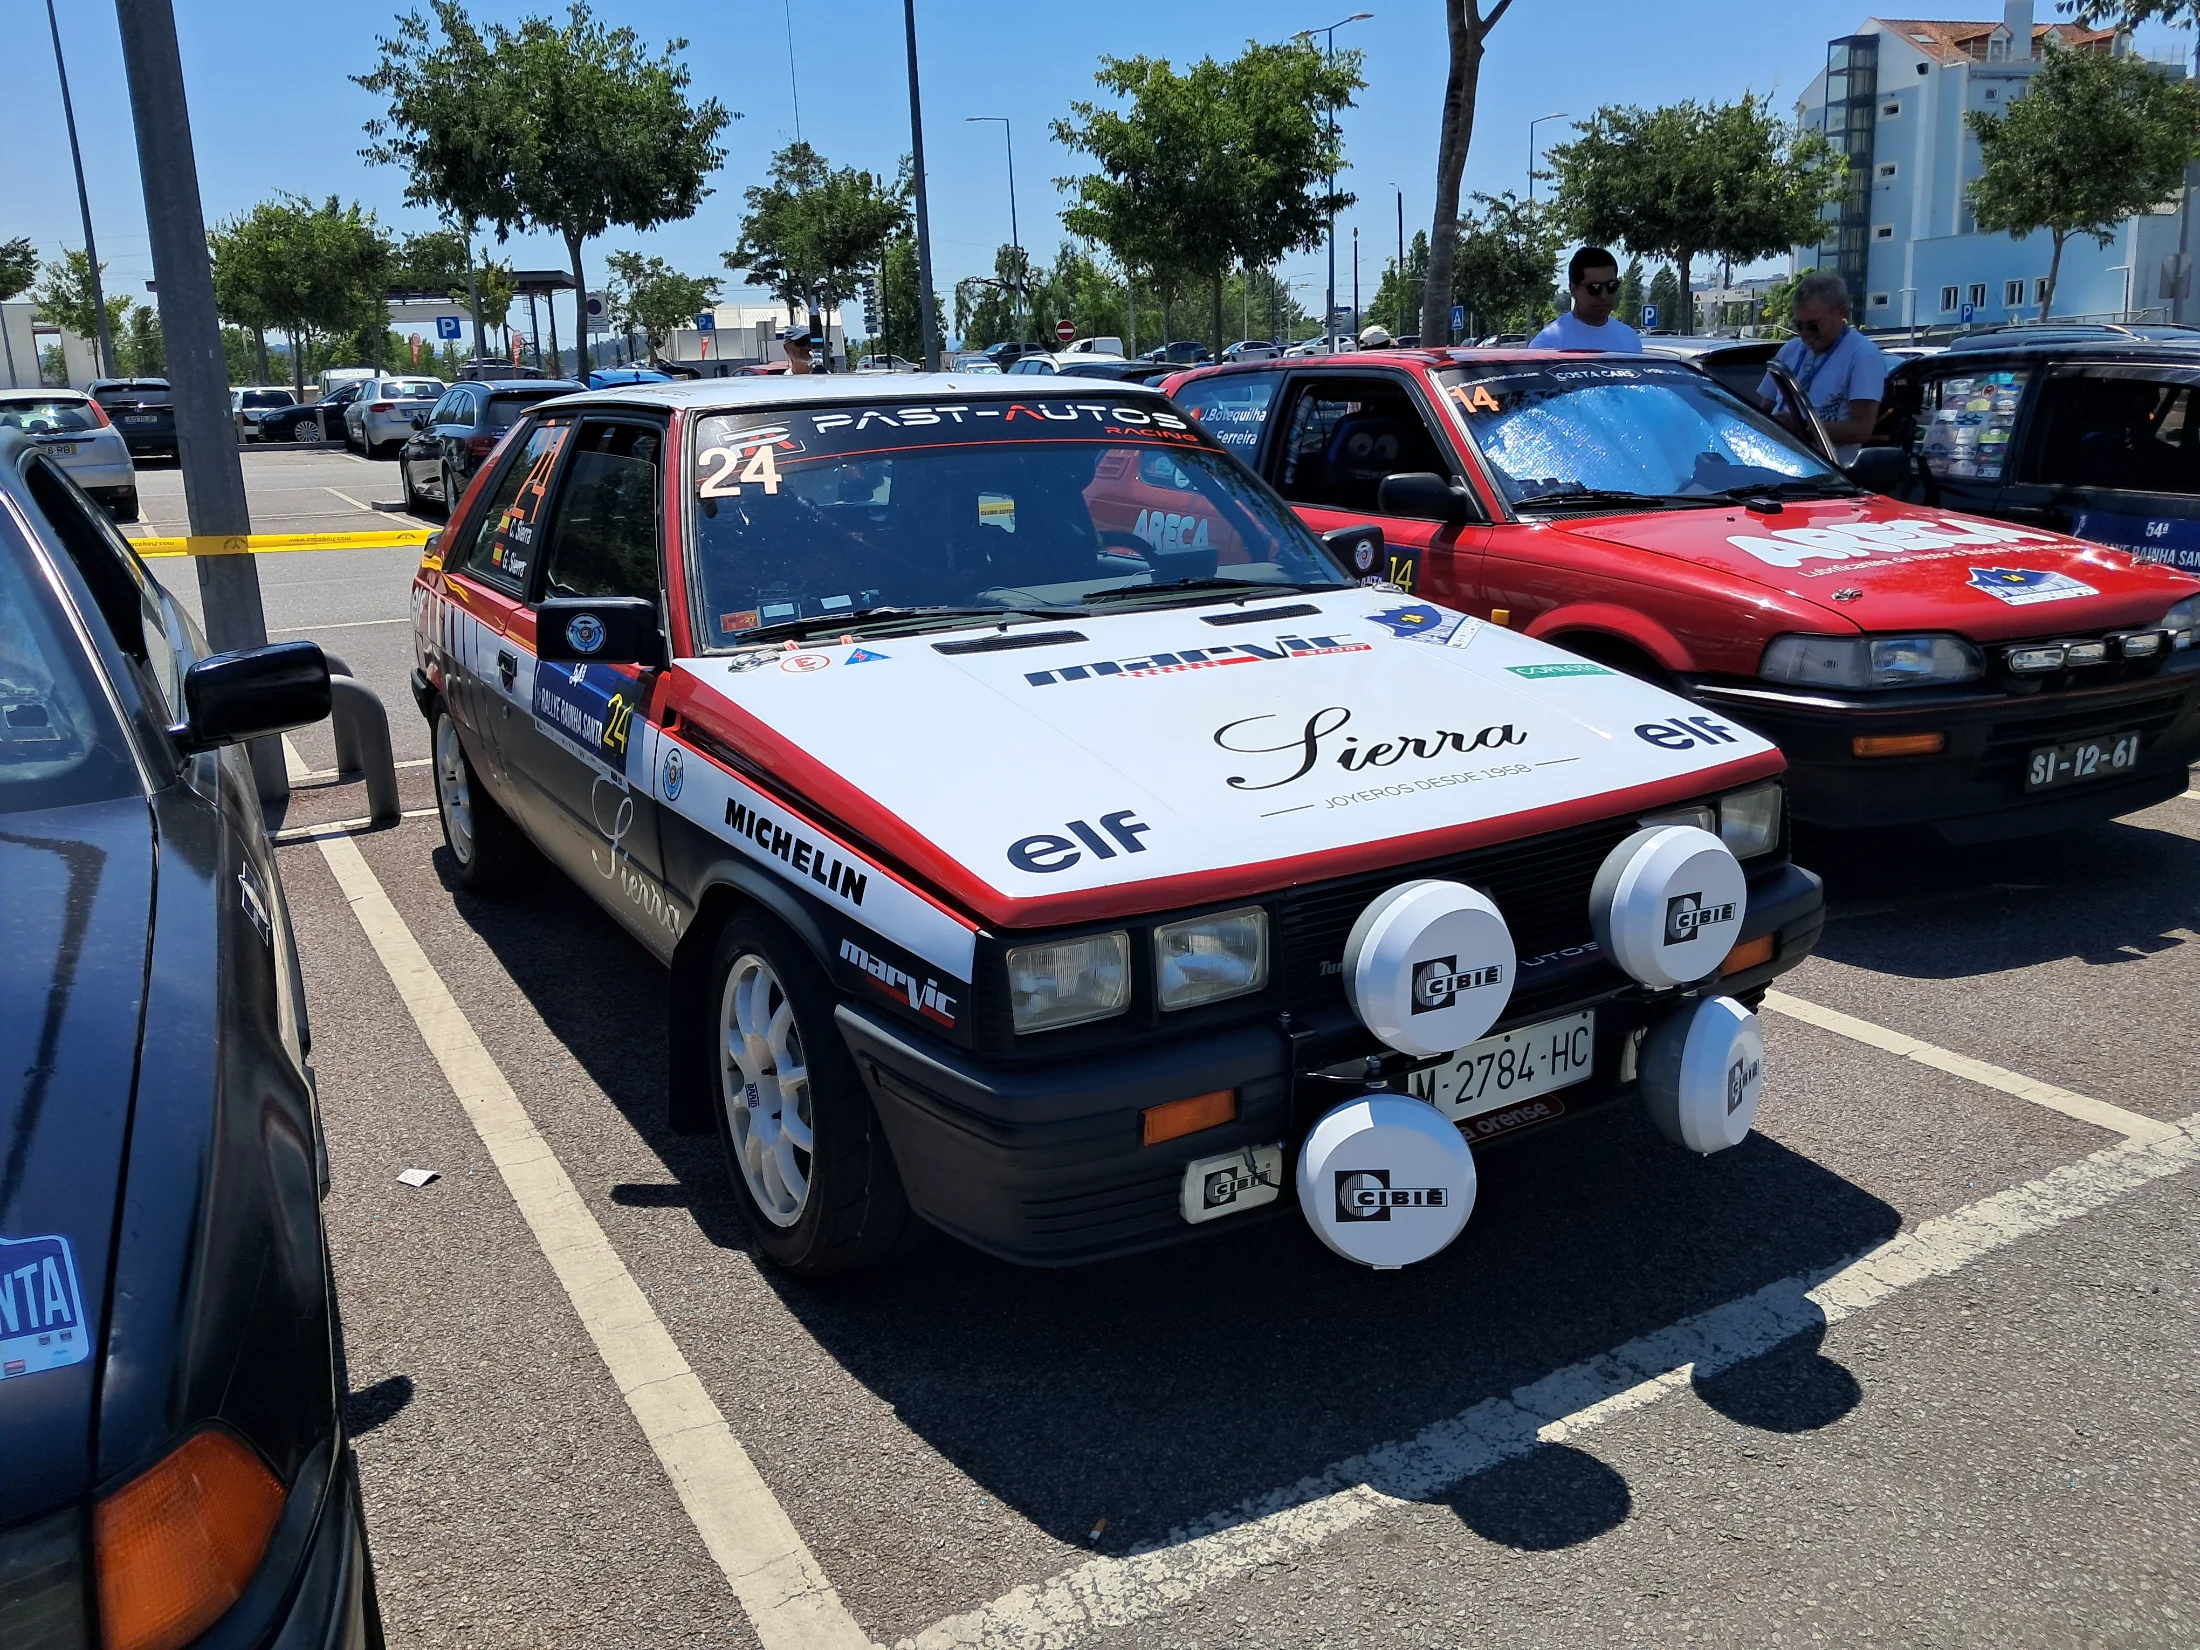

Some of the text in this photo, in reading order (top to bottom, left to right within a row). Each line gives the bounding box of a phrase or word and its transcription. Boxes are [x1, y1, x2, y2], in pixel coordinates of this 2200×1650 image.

[1555, 371, 1600, 380] COSTA
[1601, 369, 1635, 379] CARS
[1450, 386, 1500, 413] 14
[1104, 426, 1198, 442] RACING
[698, 445, 783, 499] 24
[1132, 508, 1210, 552] ARECA
[1726, 518, 2059, 568] ARECA
[1389, 556, 1413, 593] 14
[582, 713, 603, 750] SANTA
[603, 693, 635, 754] 24
[1634, 716, 1740, 750] elf
[1213, 705, 1528, 790] Sierra
[2030, 736, 2138, 785] SI-12-61
[1324, 763, 1532, 810] JOYEROS DESDE 1958
[724, 796, 868, 907] MICHELIN
[1006, 809, 1152, 874] elf
[839, 938, 958, 1020] marvic
[1476, 1101, 1551, 1134] orense
